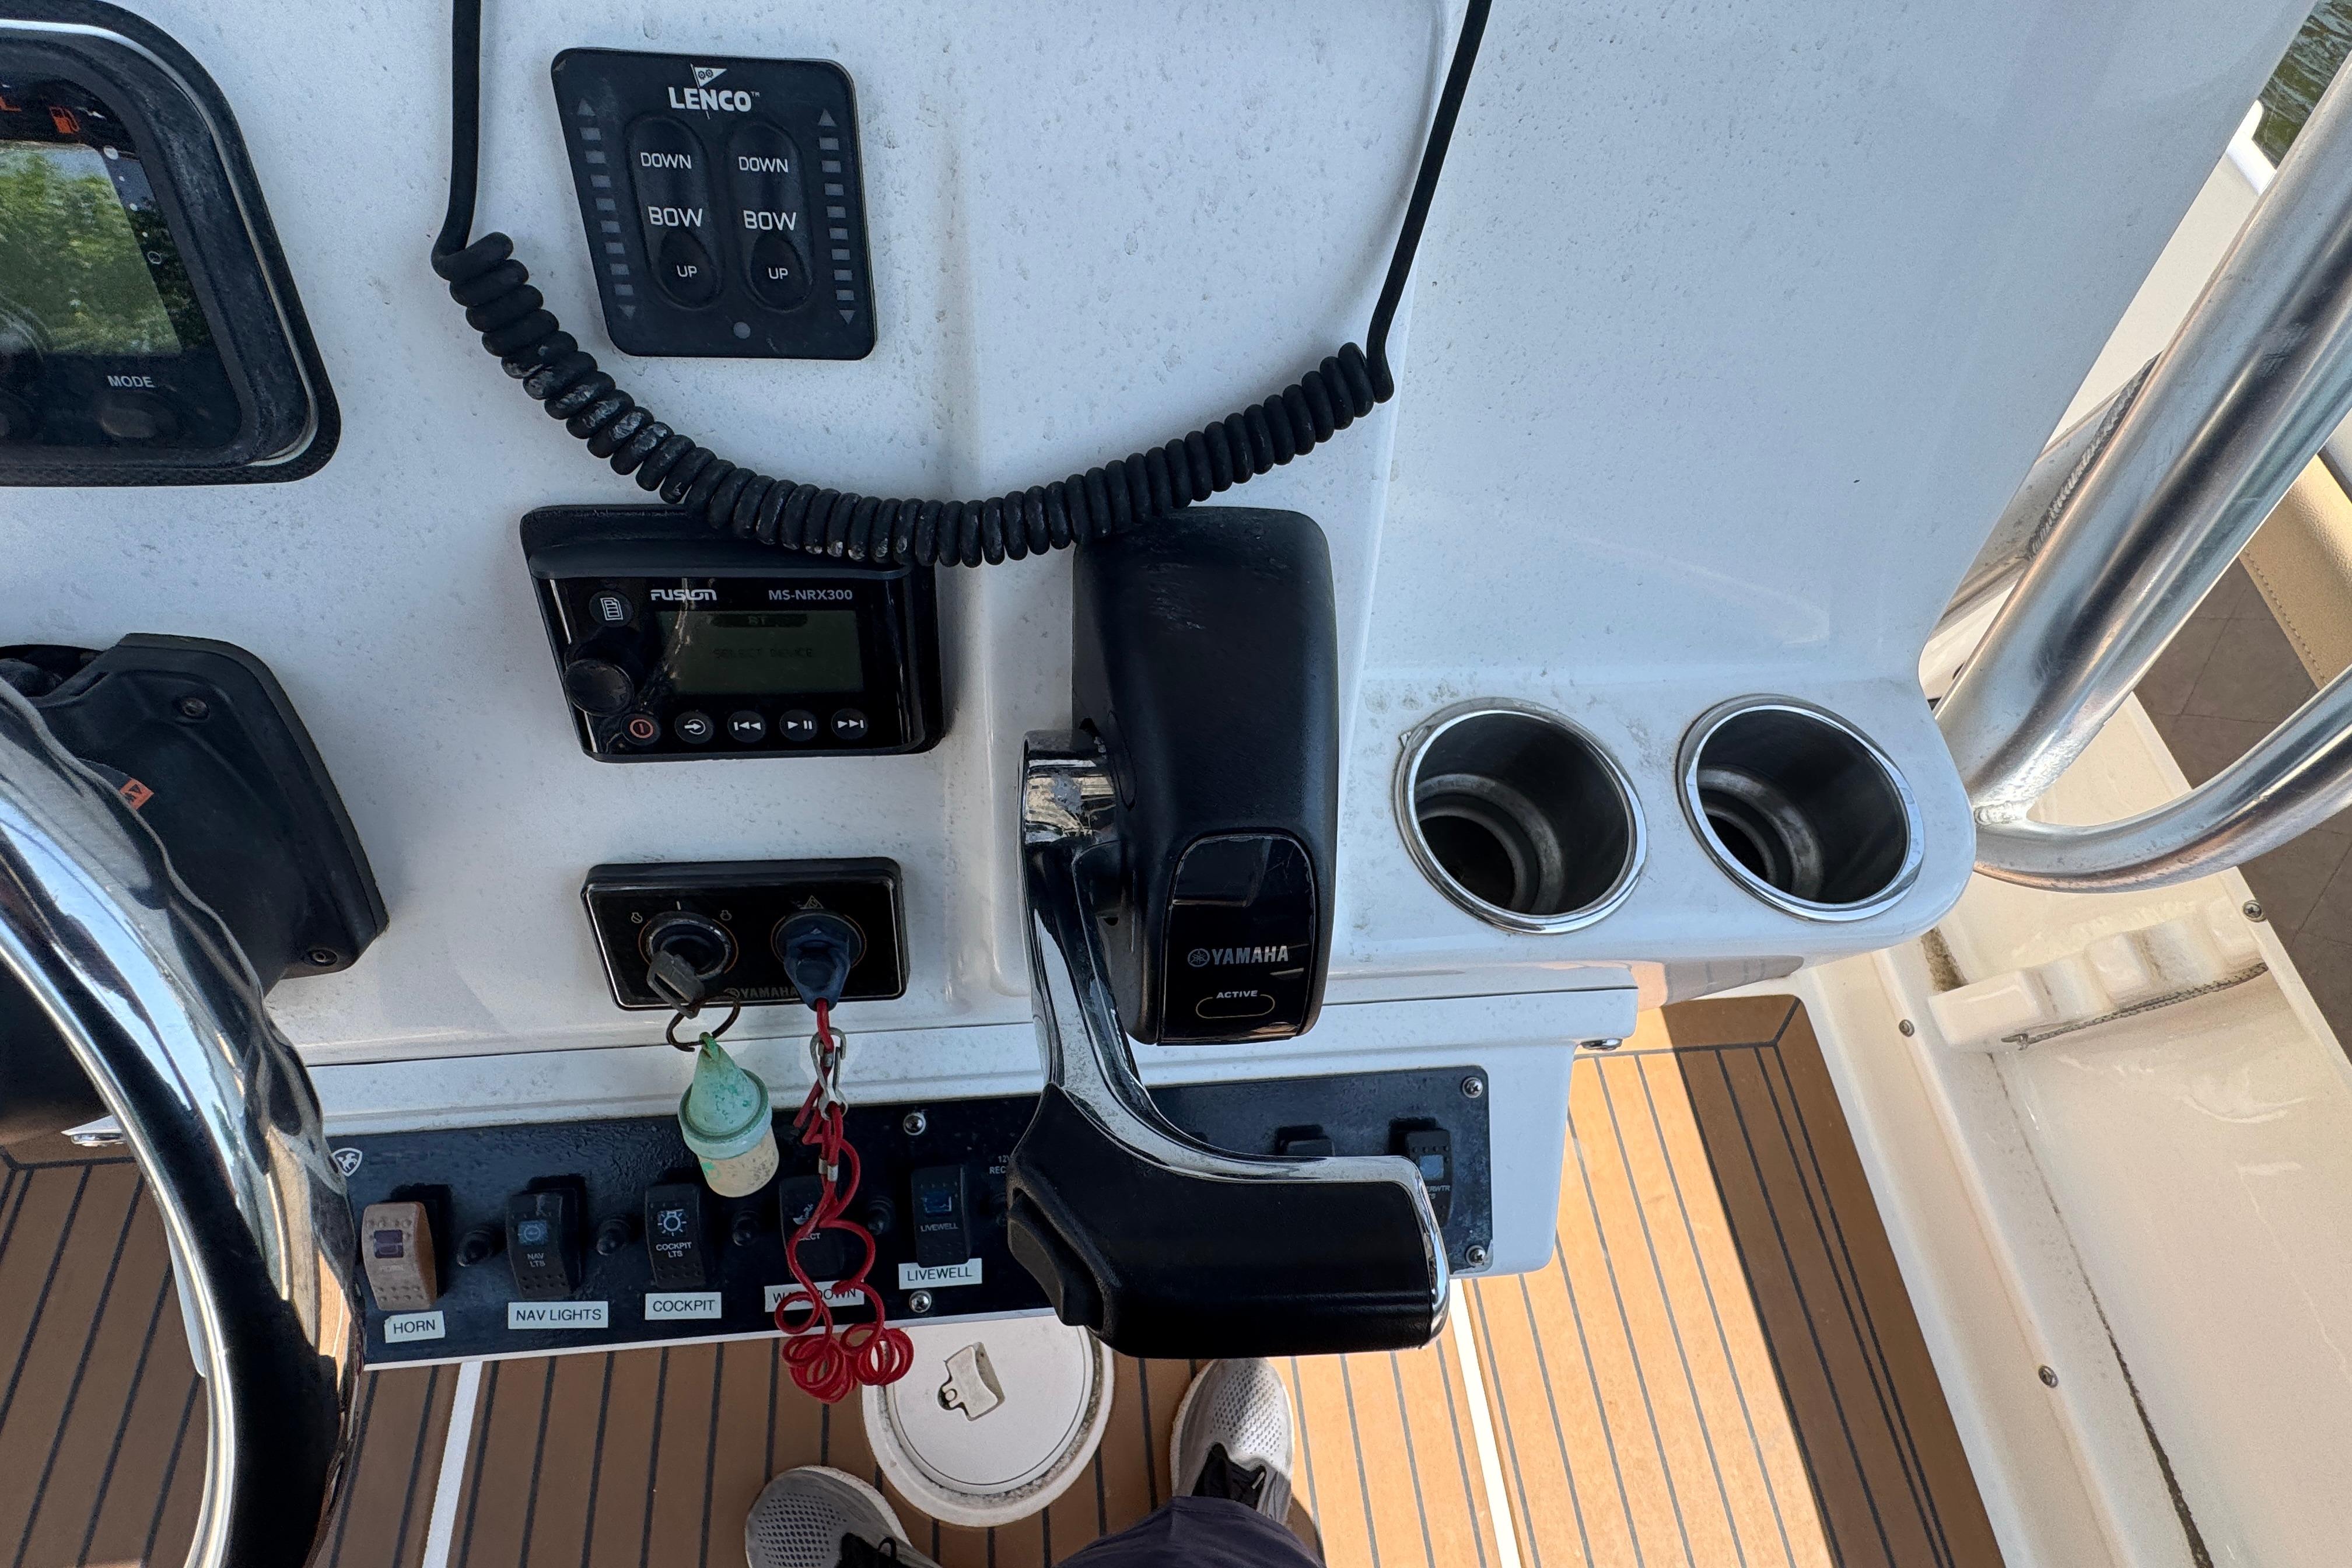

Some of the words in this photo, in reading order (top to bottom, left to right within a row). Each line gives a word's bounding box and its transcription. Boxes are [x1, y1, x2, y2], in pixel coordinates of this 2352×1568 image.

[640, 152, 692, 170] DOWN
[738, 156, 789, 173] DOWN
[648, 206, 702, 227] BOW
[743, 209, 797, 231] BOW
[676, 265, 698, 278] UP
[768, 268, 789, 280] UP
[107, 375, 156, 388] MODE
[650, 589, 717, 601] FUSION
[768, 589, 853, 601] MS-NRX300
[1212, 945, 1289, 965] YAMAHA
[740, 986, 799, 998] YAMAHA
[1216, 990, 1259, 999] ACTIVE
[921, 1223, 959, 1232] LIVEWELL
[655, 1241, 692, 1251] COCKPIT
[667, 1250, 684, 1258] LTS
[907, 1266, 974, 1282] LIVEWELL
[653, 1299, 716, 1312] COCKPIT
[516, 1310, 546, 1321] NAV
[550, 1308, 602, 1321] LIGHTS
[393, 1319, 436, 1334] HORN
